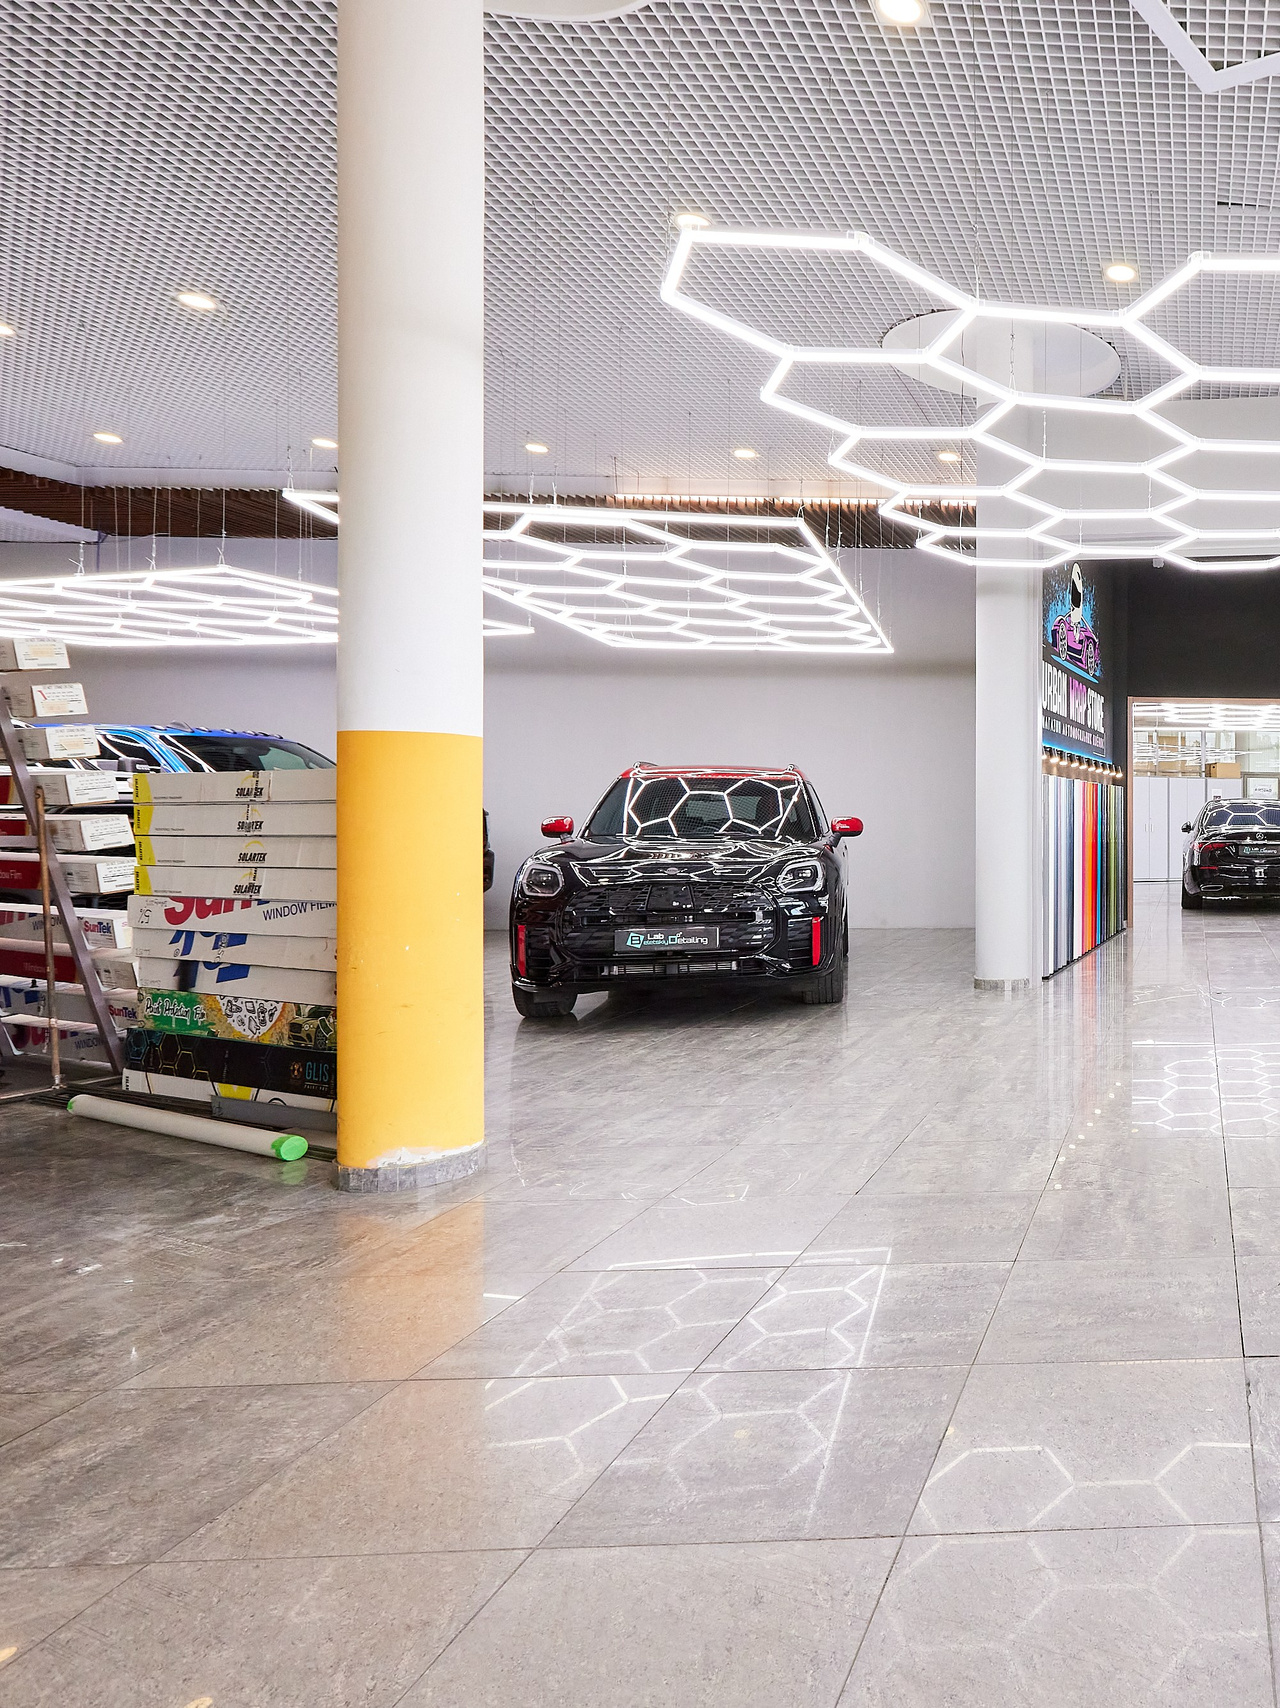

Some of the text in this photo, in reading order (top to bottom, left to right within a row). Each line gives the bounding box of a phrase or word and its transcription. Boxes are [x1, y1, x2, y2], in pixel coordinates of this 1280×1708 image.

[1042, 660, 1105, 734] URBAN WRAP STORE
[235, 787, 264, 797] SOLAEK
[236, 821, 264, 830] SOTEK
[237, 852, 267, 862] SOLARTEK
[263, 901, 308, 921] WINDOW
[83, 920, 112, 934] SunTek
[109, 1004, 137, 1019] SunTek
